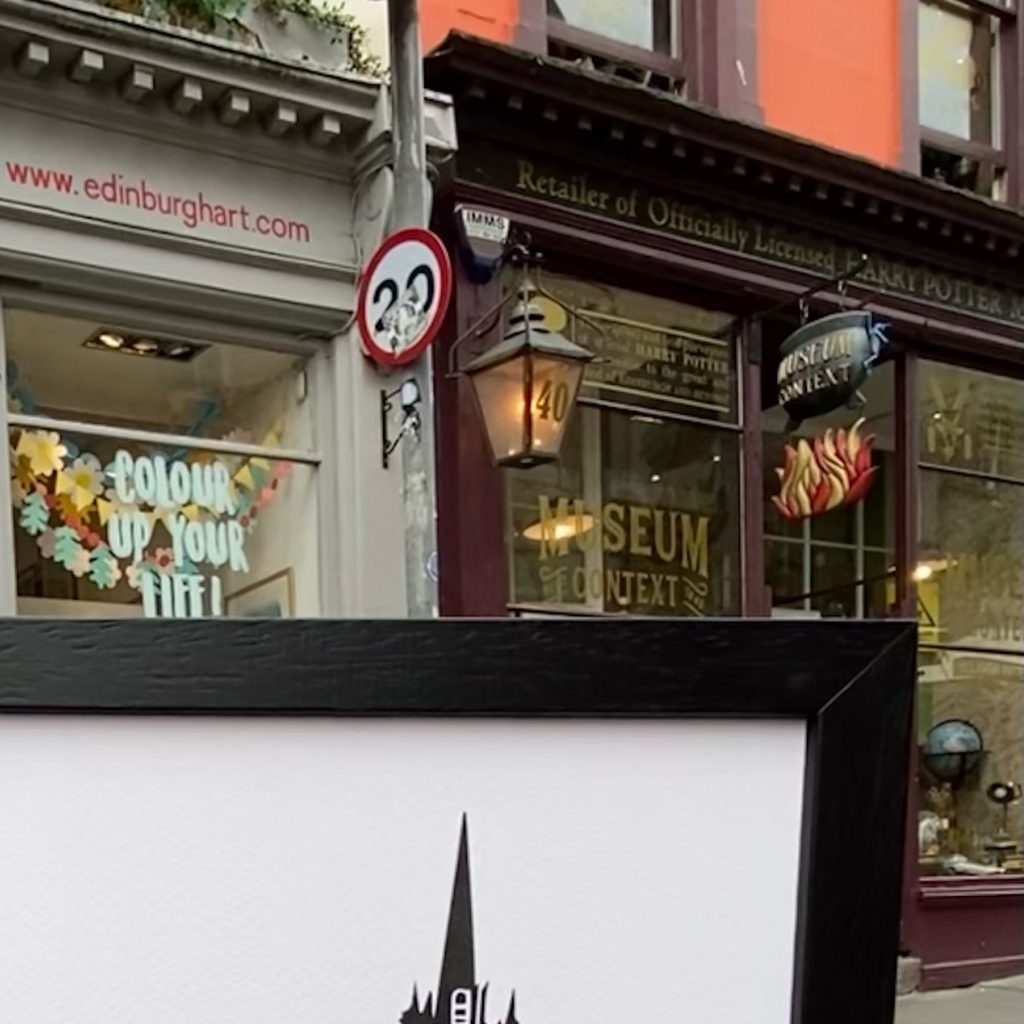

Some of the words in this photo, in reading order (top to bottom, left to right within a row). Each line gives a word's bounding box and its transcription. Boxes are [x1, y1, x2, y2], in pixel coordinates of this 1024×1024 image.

[6, 161, 310, 243] www.edinburghart.com
[516, 159, 610, 210] Retailer
[616, 190, 637, 217] of
[648, 198, 750, 250] Officially
[753, 222, 836, 275] Licensed
[923, 273, 1003, 317] POTTER
[535, 379, 569, 423] 40
[114, 449, 237, 516] COLOUR
[107, 510, 150, 566] UP
[168, 511, 250, 574] YOUR
[537, 495, 710, 578] MUSEUM
[572, 565, 679, 607] CONTEXT
